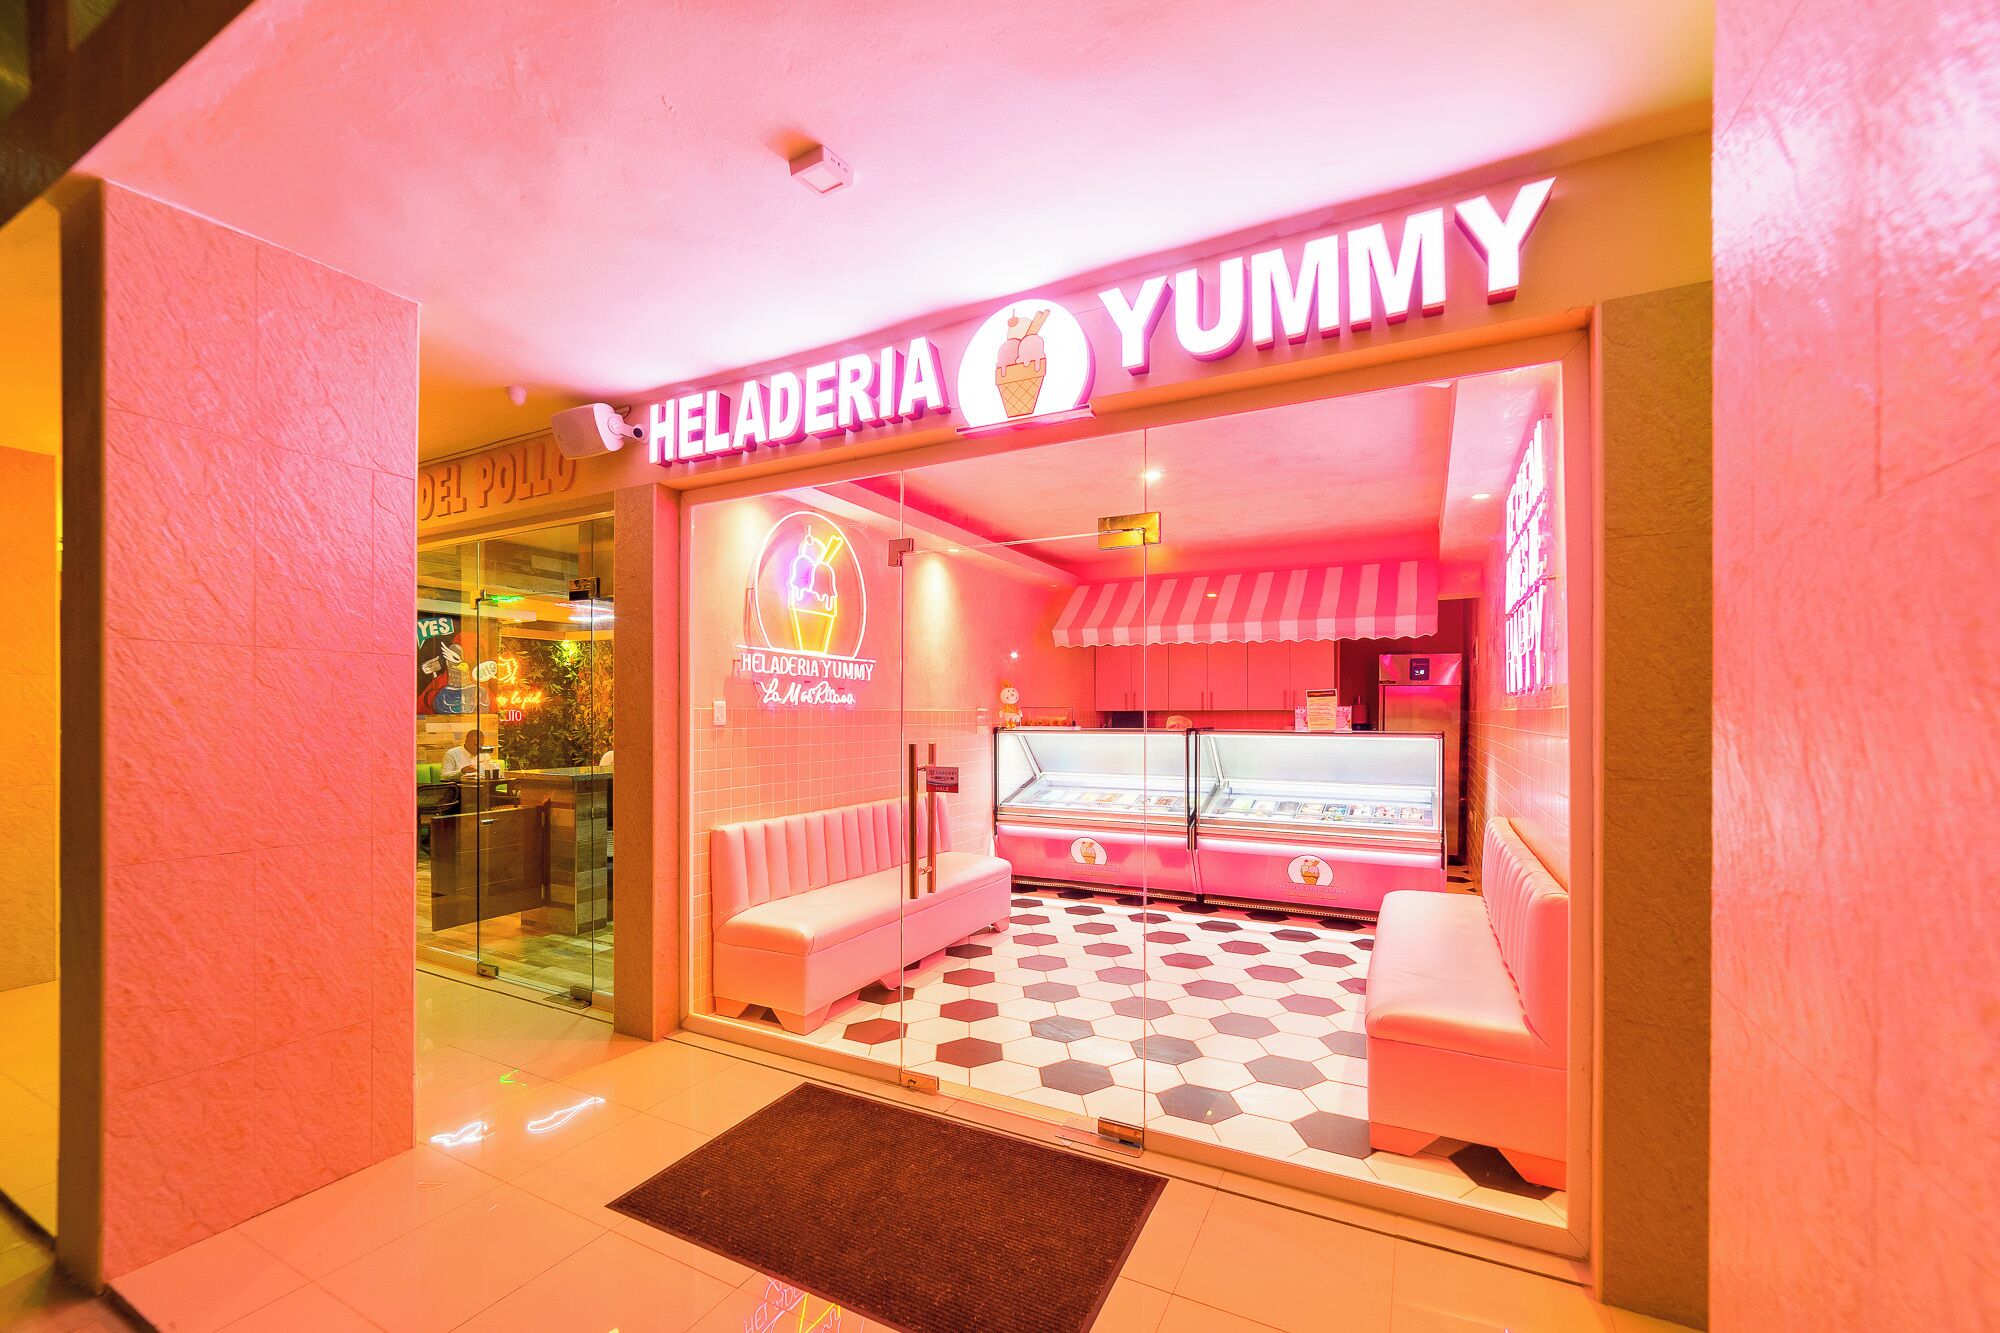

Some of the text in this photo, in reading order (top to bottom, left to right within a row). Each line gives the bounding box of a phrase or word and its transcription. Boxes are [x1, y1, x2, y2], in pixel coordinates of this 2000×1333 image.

[1098, 177, 1556, 376] YUMMY
[648, 336, 950, 467] HELADERIA
[418, 441, 577, 521] DEL POLLO
[417, 617, 450, 637] YES
[741, 653, 874, 681] HELADERIA YUMMY
